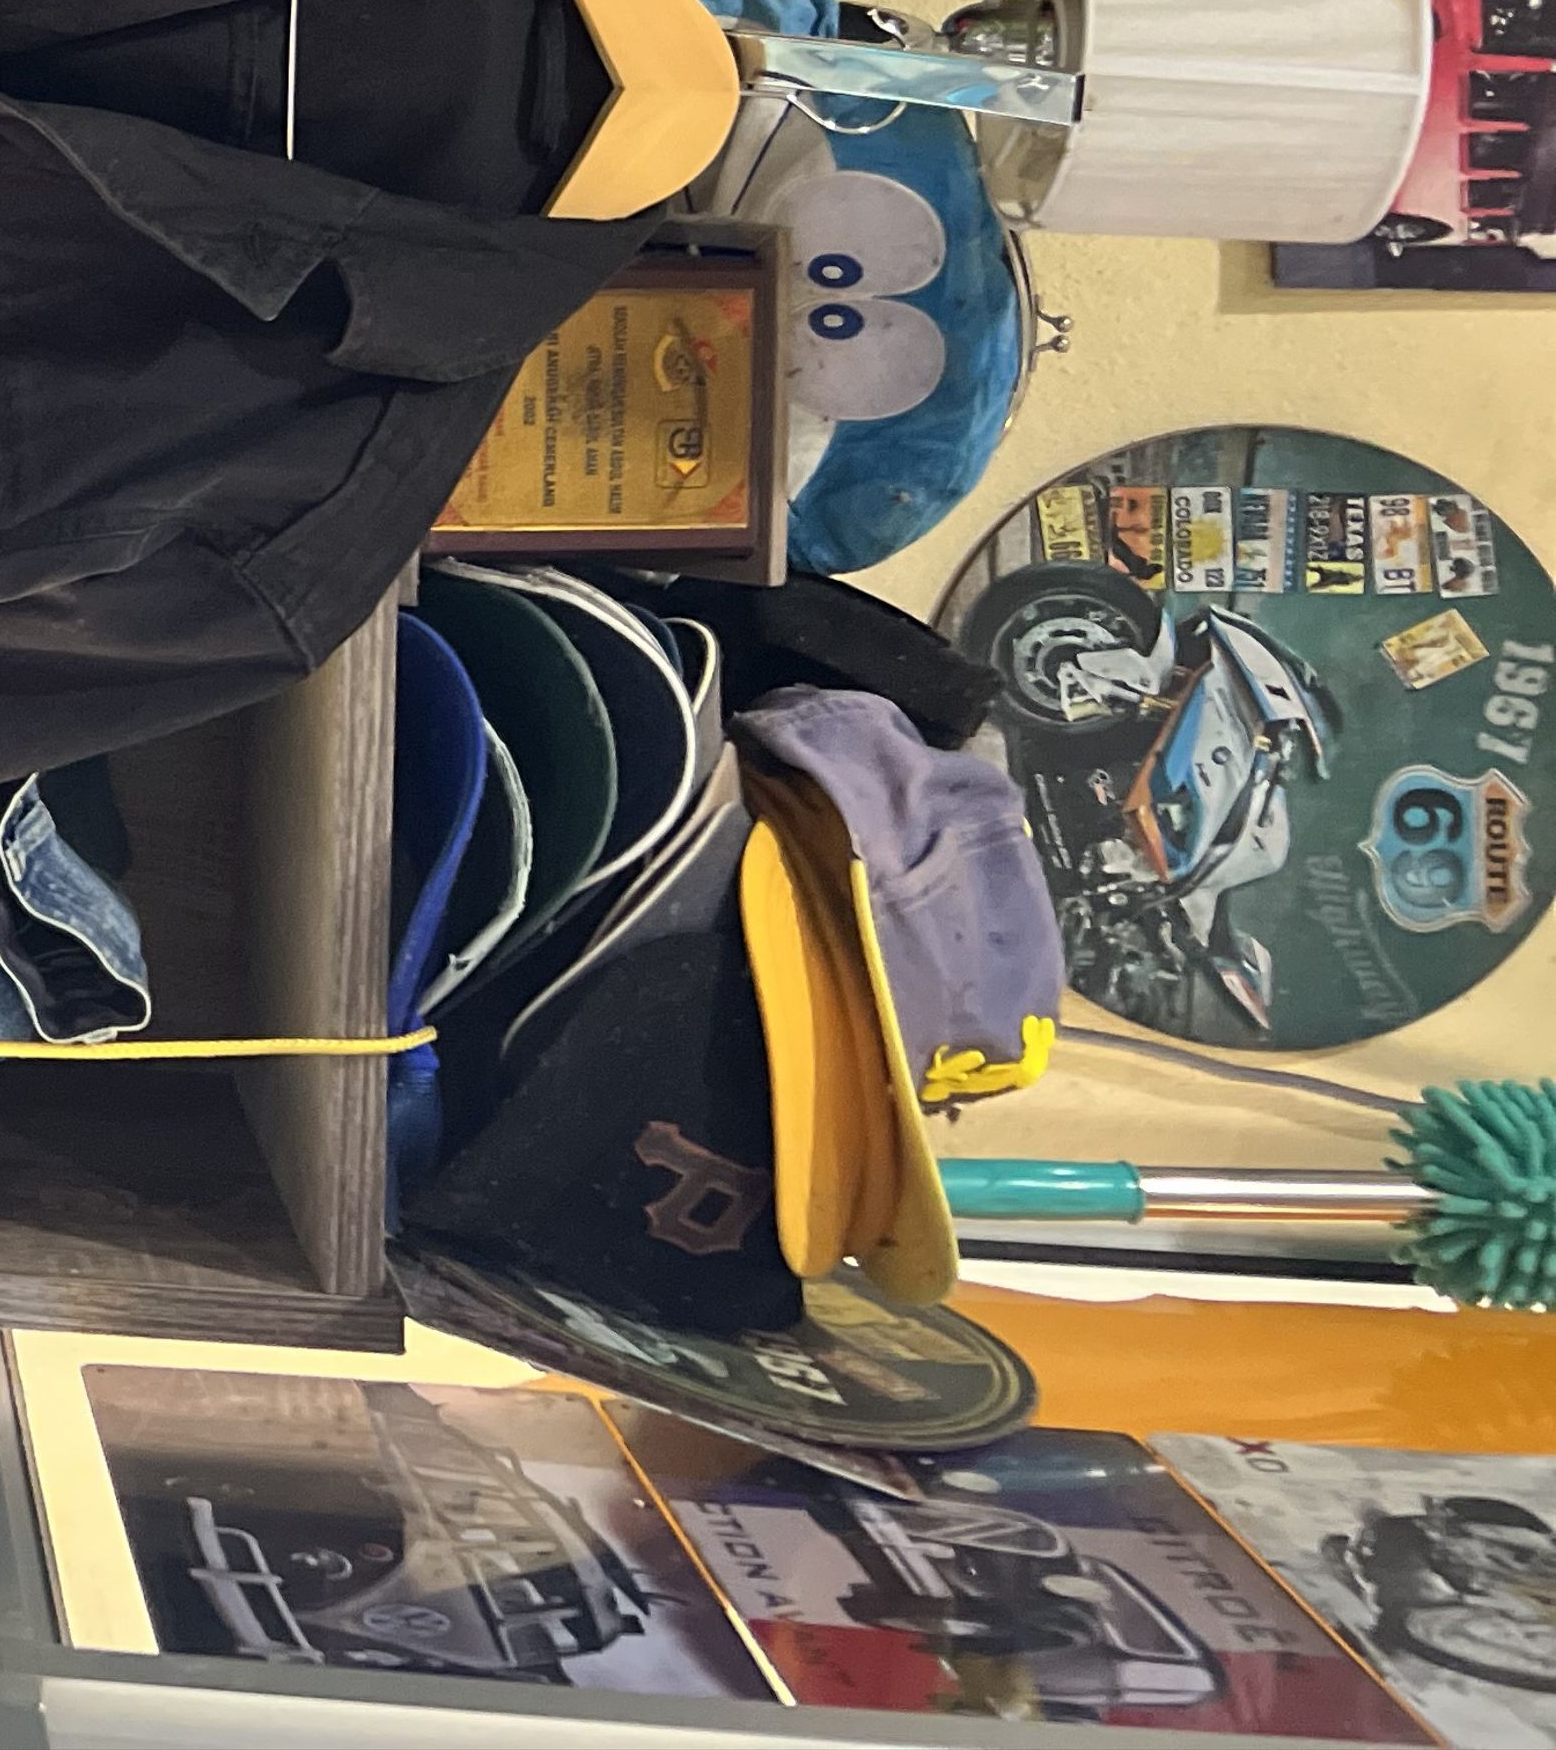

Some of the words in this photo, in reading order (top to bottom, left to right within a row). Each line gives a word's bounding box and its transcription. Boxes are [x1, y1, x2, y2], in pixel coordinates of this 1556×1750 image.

[1175, 495, 1194, 583] COLORADO
[1345, 497, 1365, 562] TEXAS
[1476, 640, 1556, 764] 1967
[1390, 788, 1464, 912] 69
[1485, 797, 1510, 906] ROUTE
